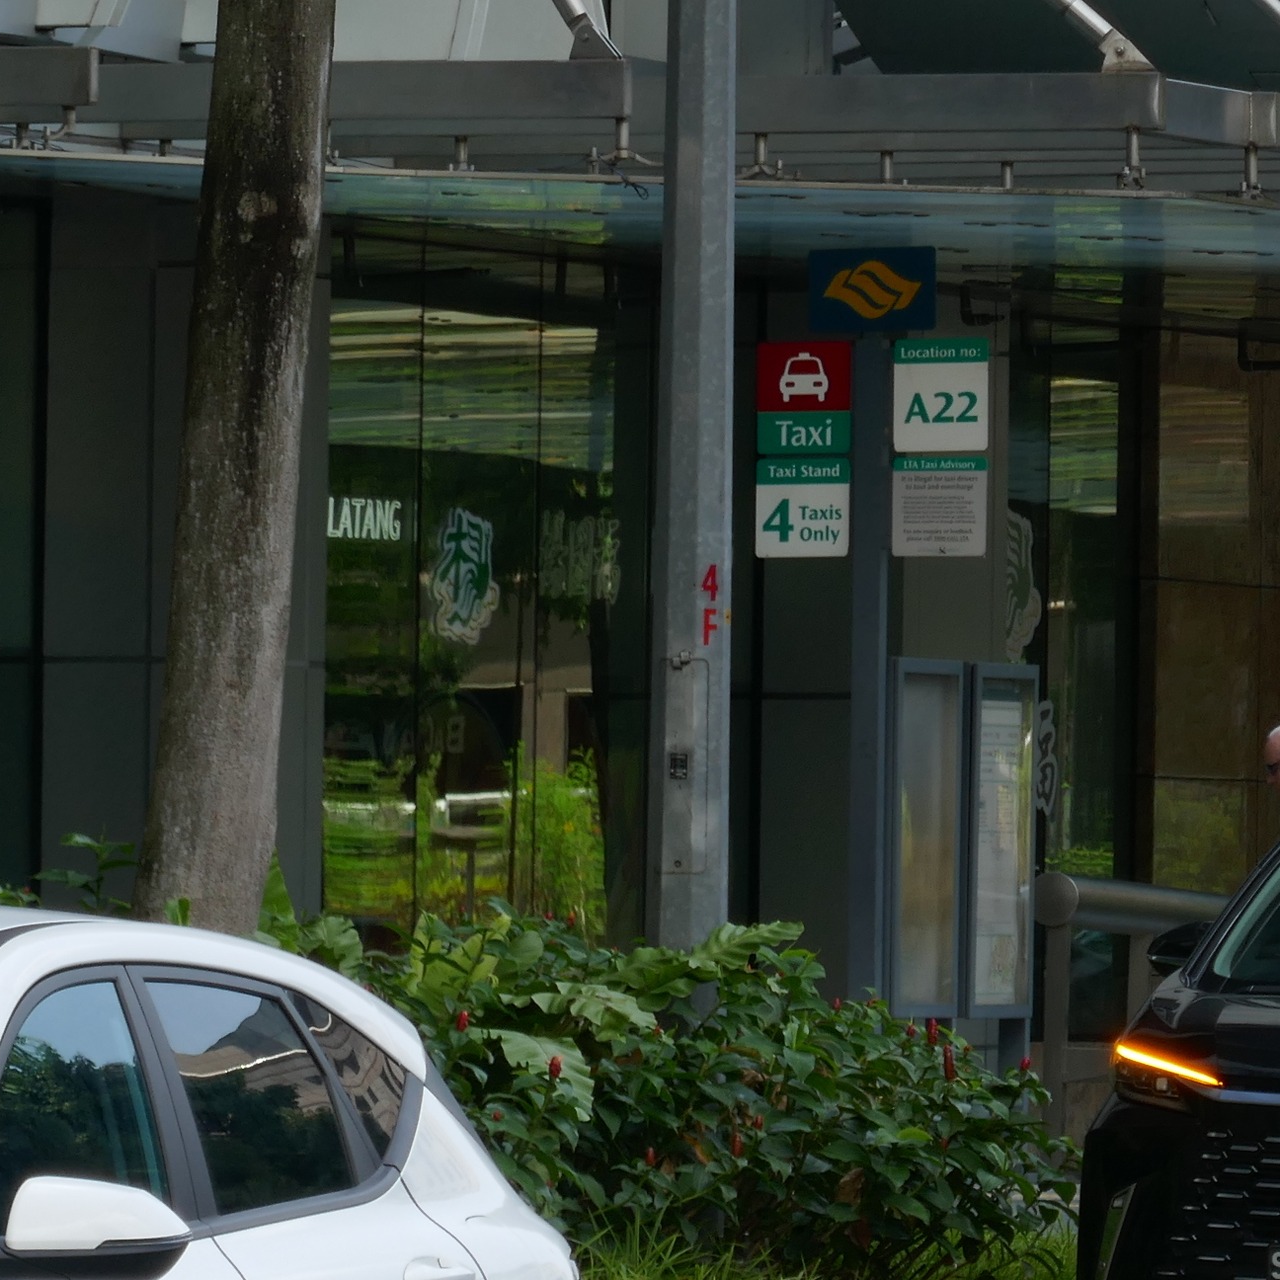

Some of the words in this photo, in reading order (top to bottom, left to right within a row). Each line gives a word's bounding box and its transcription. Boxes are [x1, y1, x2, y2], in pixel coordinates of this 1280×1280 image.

[900, 346, 956, 359] Location
[960, 348, 981, 358] no:
[904, 391, 978, 424] A22
[775, 418, 832, 446] Taxi
[768, 464, 796, 478] Taxi
[801, 463, 840, 477] Stand
[903, 460, 919, 469] LTA
[921, 460, 938, 469] Taxi
[940, 460, 977, 469] Advisory
[327, 497, 401, 541] LATANG
[762, 498, 794, 543] 4
[798, 504, 842, 521] Taxis
[800, 525, 840, 545] Only
